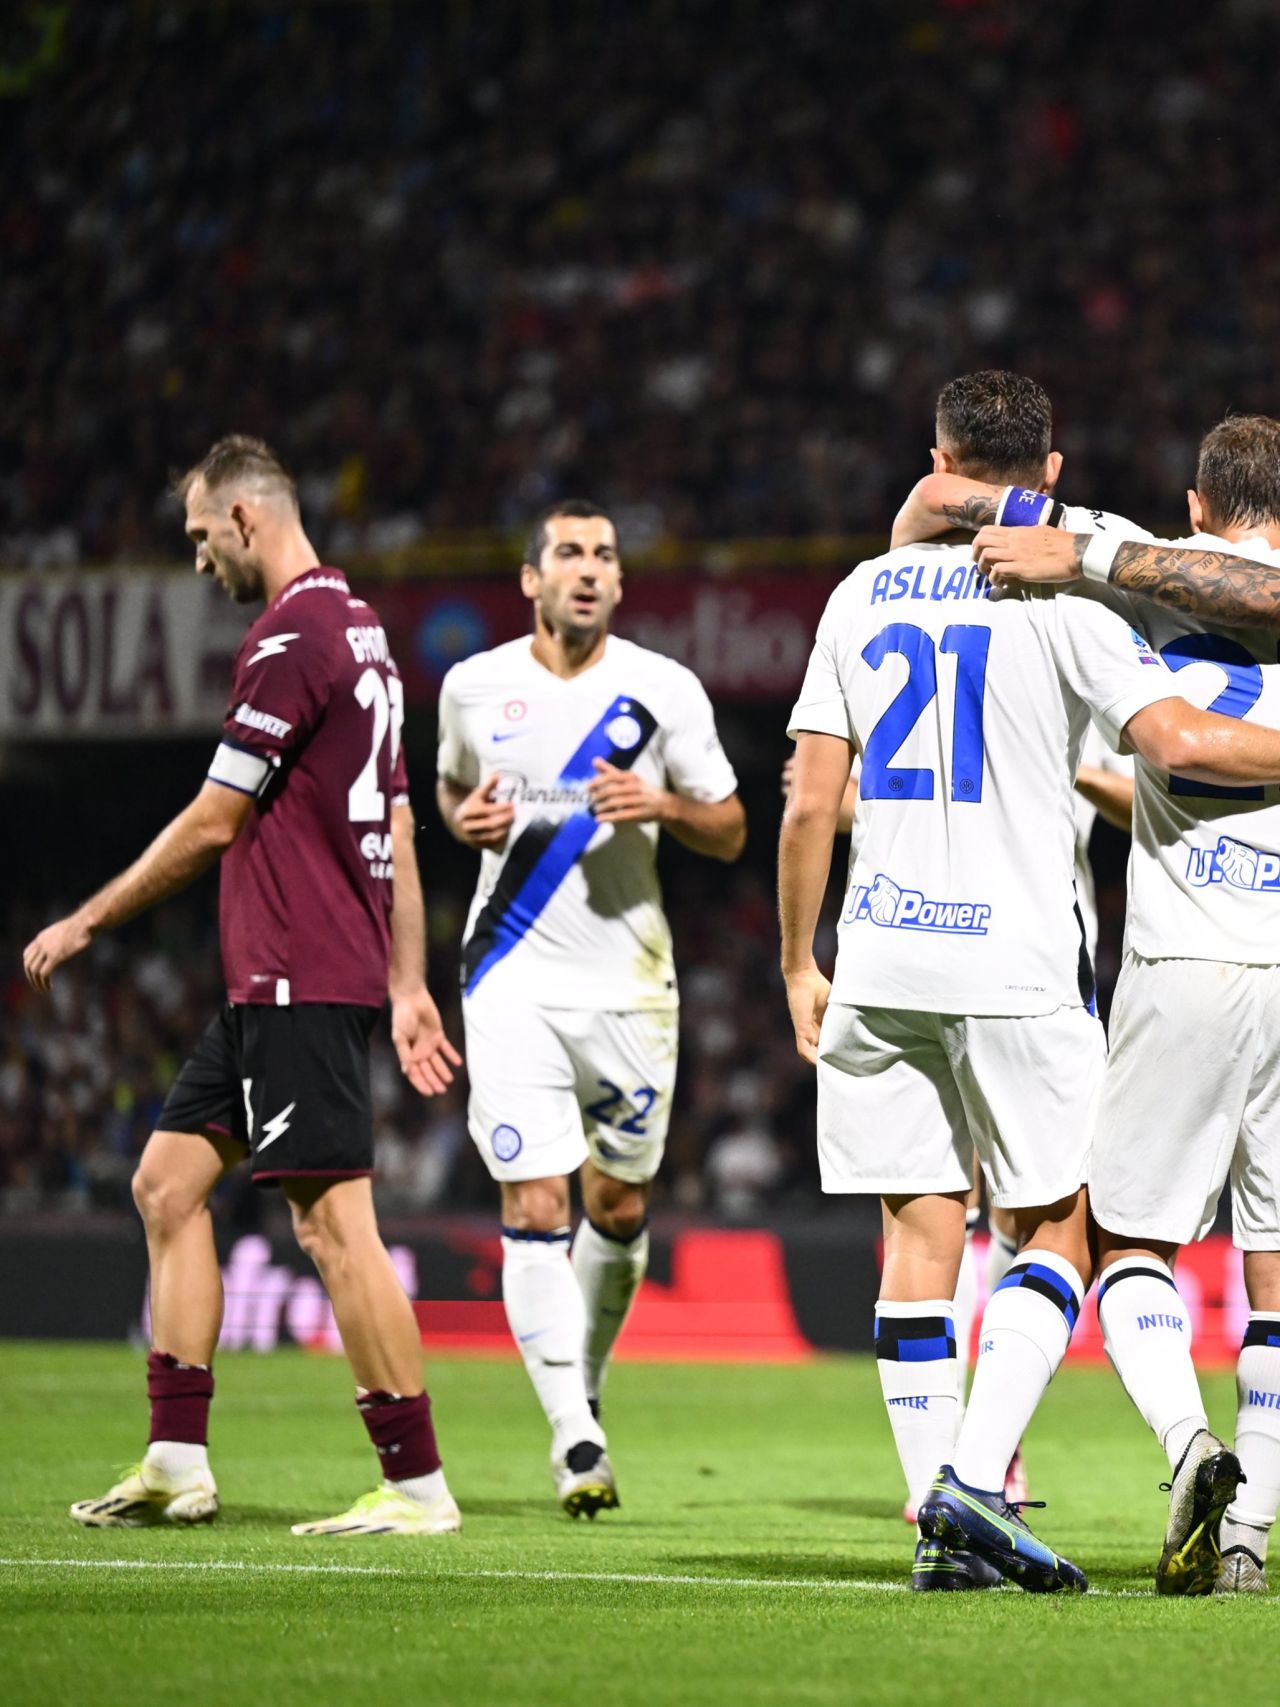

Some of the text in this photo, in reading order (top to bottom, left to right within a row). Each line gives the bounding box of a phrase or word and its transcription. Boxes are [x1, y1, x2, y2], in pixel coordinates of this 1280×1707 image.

[12, 583, 175, 718] SOLA
[860, 623, 991, 803] 21
[584, 1079, 657, 1135] 22
[1137, 1313, 1184, 1332] INTER
